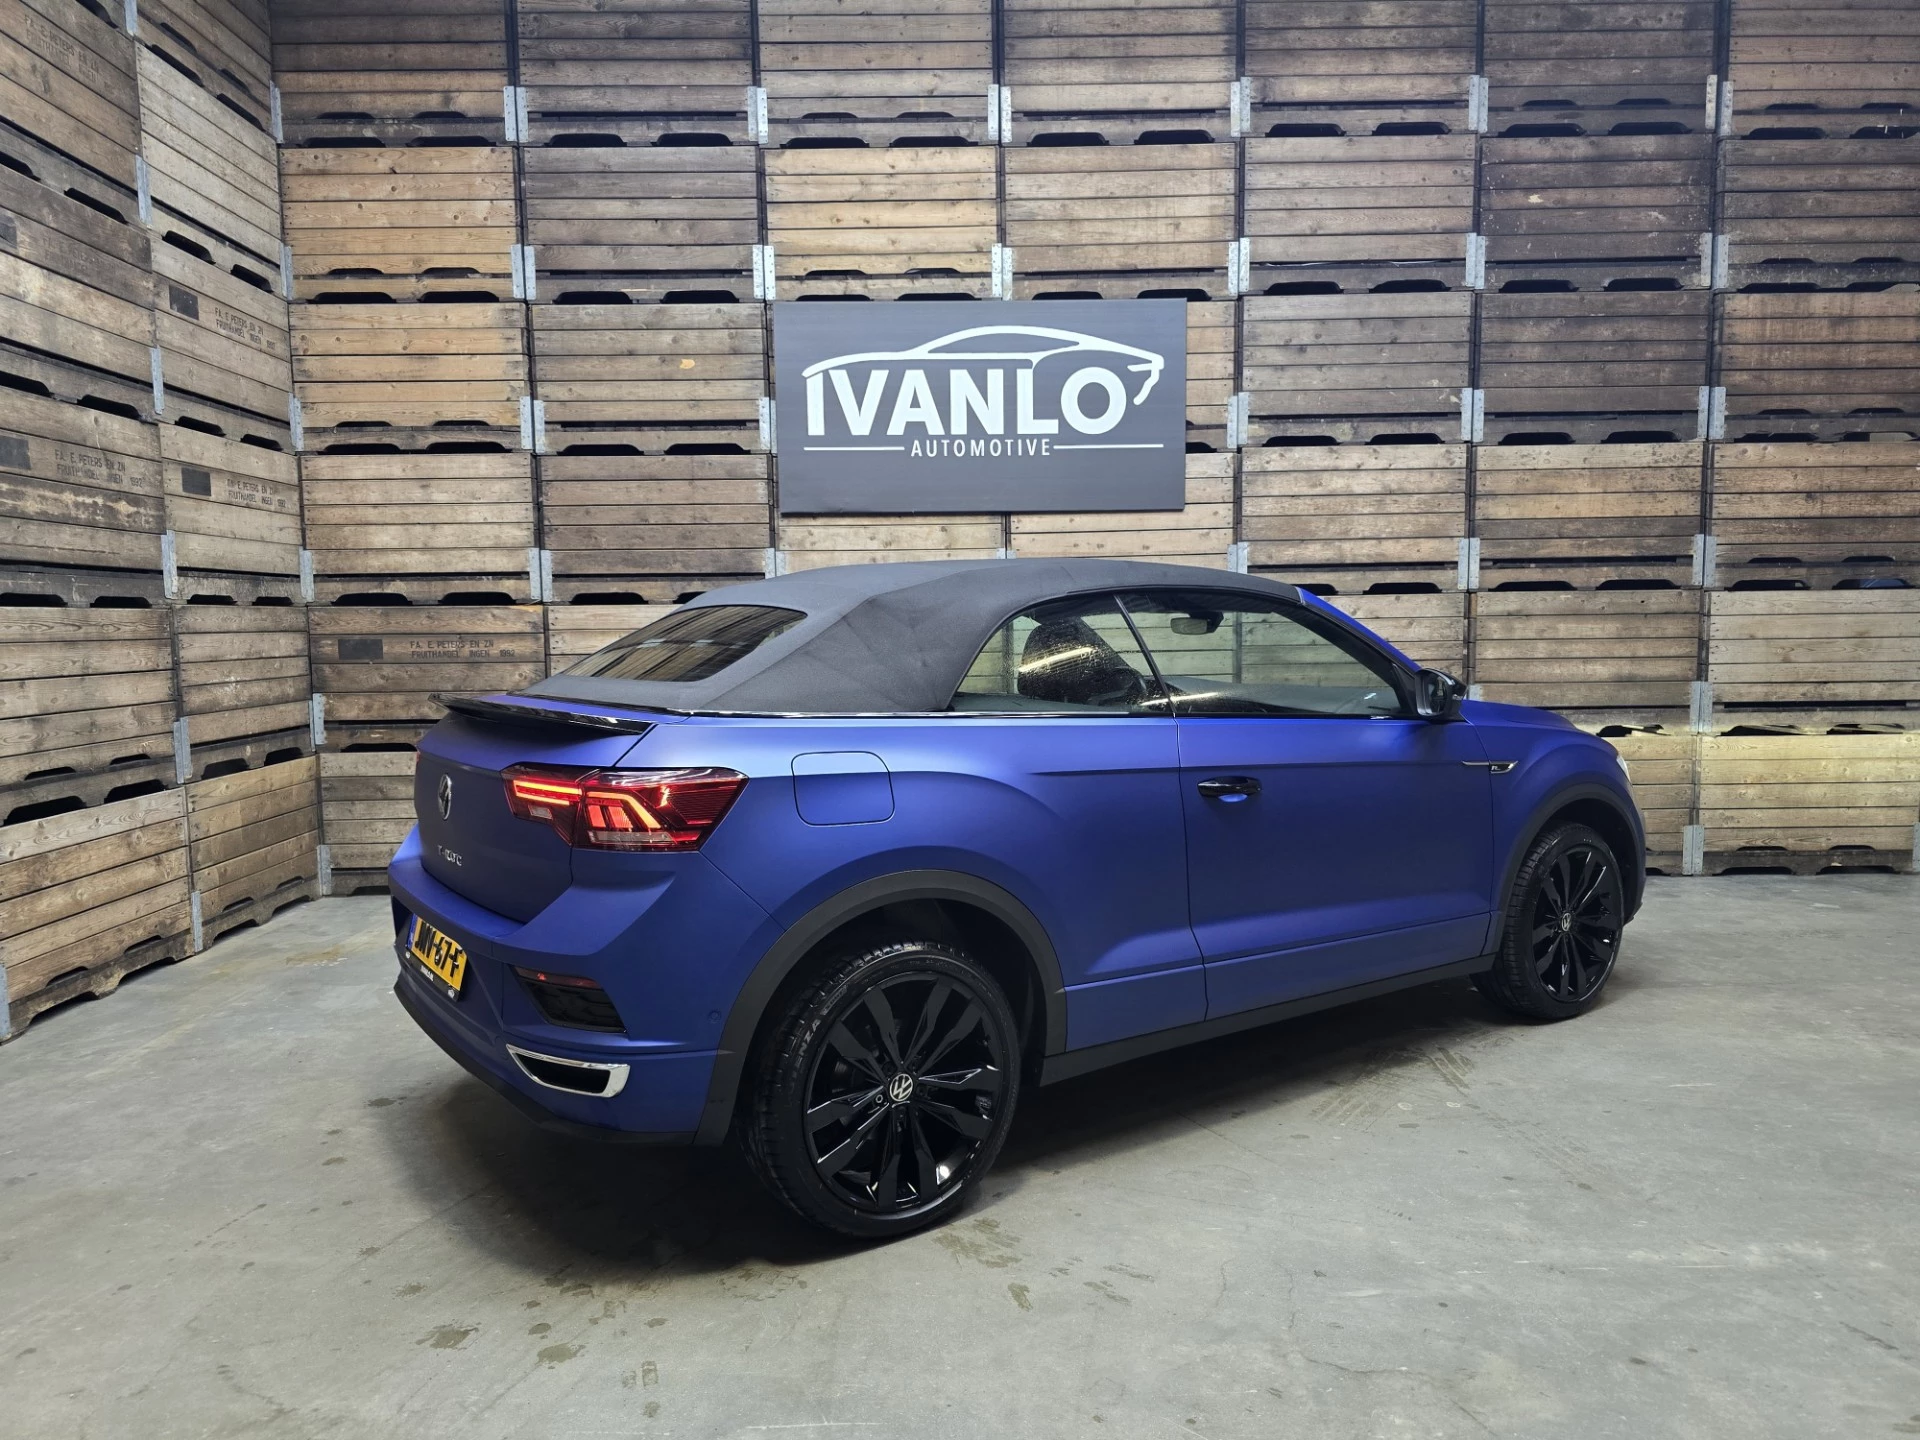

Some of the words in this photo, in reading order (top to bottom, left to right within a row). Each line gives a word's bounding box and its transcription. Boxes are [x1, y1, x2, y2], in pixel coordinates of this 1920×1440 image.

[806, 366, 1127, 436] IVANLO
[911, 439, 1051, 458] AUTOMOTIVE
[79, 454, 103, 468] PETERS
[117, 461, 126, 473] ZN
[437, 640, 465, 650] PETERS
[470, 640, 480, 649] EN
[484, 640, 494, 649] ZN
[411, 650, 460, 660] FRUITHANDEL
[469, 650, 490, 659] INGEN
